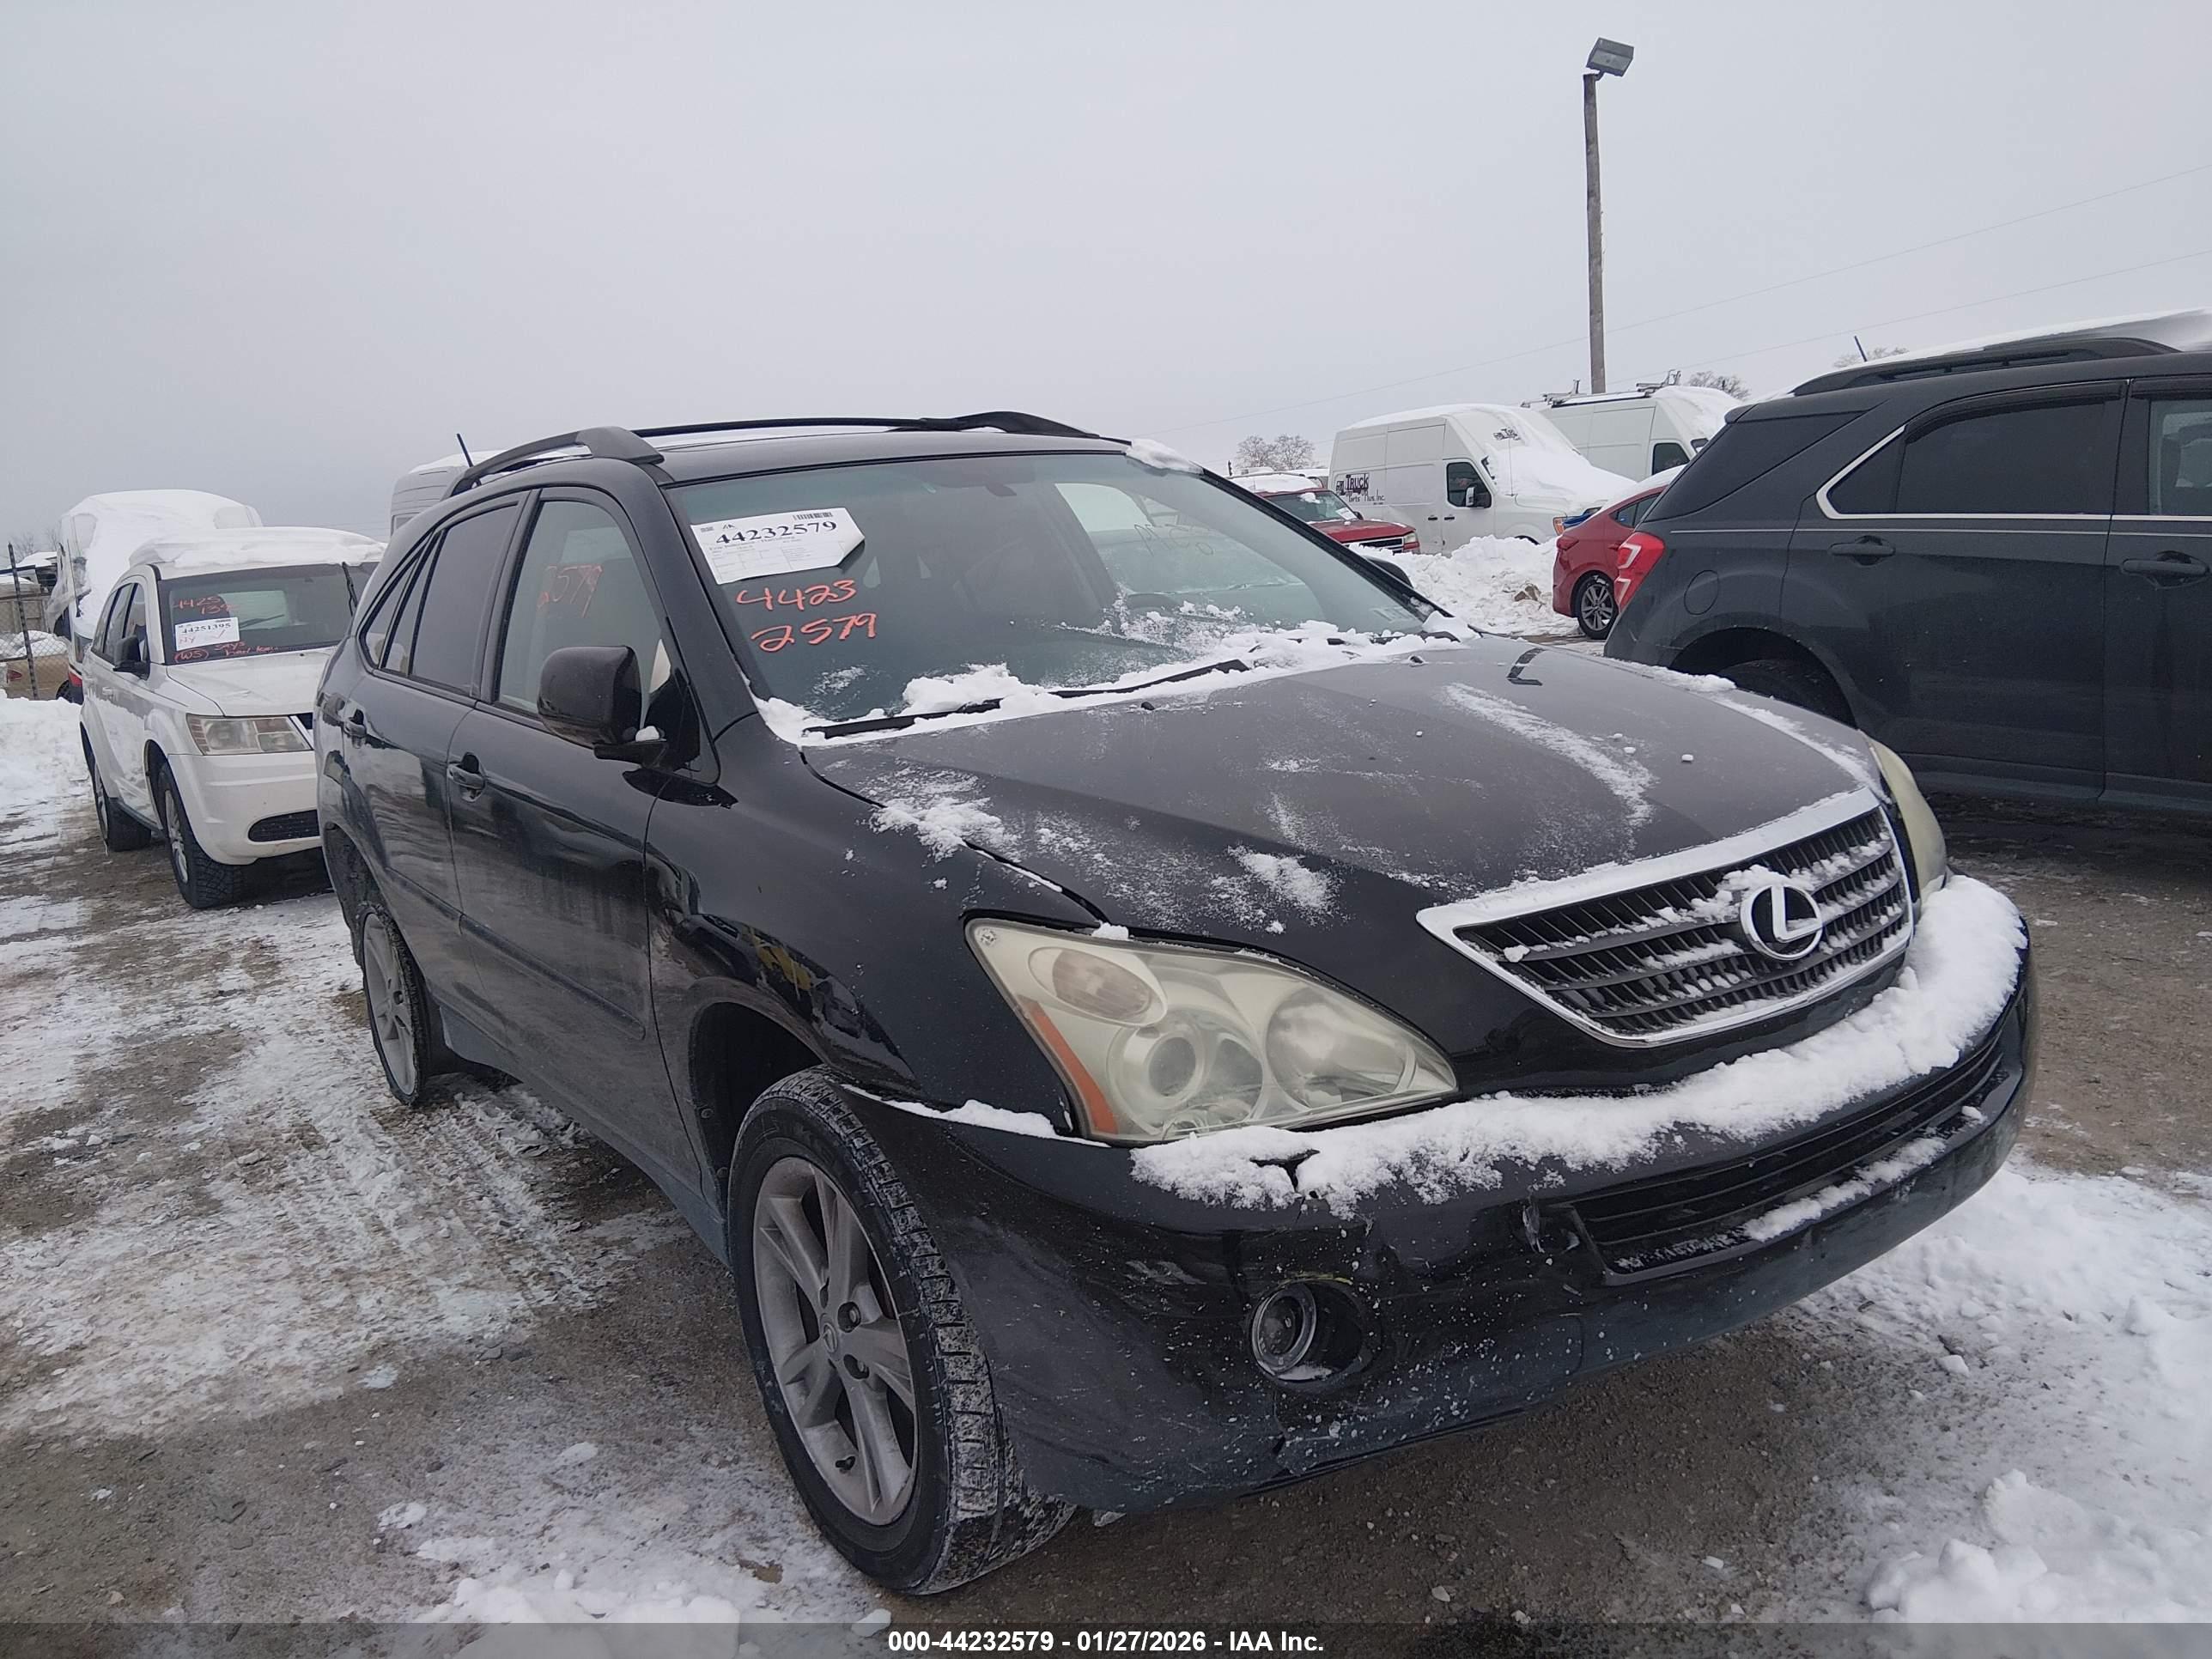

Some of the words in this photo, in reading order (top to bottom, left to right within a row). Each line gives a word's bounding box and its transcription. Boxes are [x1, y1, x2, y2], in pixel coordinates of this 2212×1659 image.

[716, 520, 837, 544] 44232579
[736, 579, 857, 611] 4423
[750, 612, 878, 653] 2579
